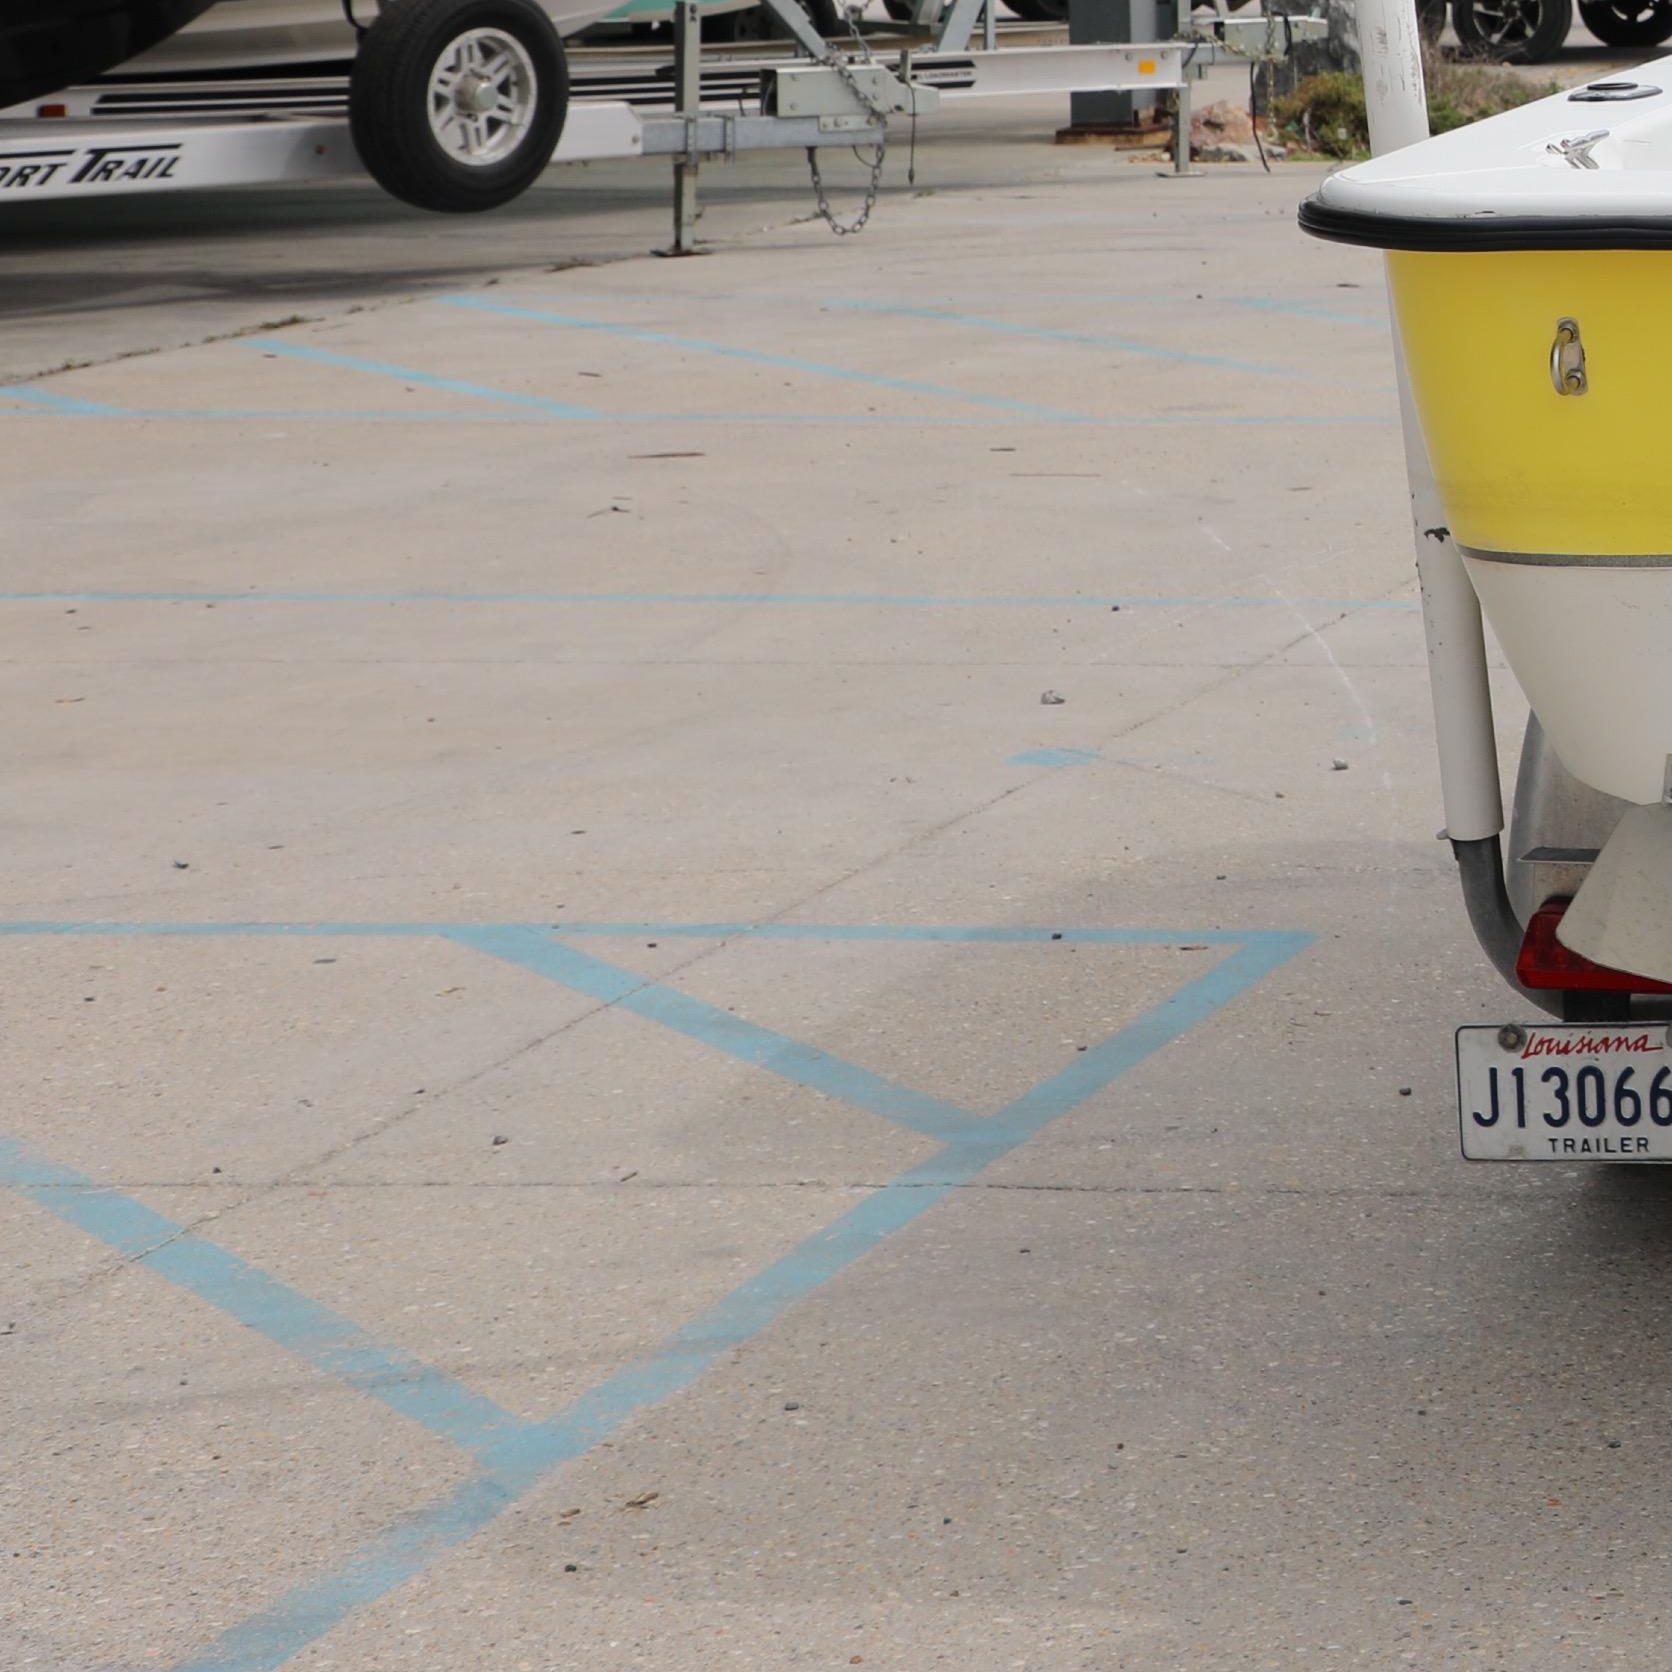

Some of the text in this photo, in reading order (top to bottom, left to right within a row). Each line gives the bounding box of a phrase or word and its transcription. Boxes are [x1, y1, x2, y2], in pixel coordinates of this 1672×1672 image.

[70, 143, 183, 184] TRAIL
[1520, 1030, 1664, 1059] Louisiana
[1548, 1137, 1650, 1153] TRAILER
